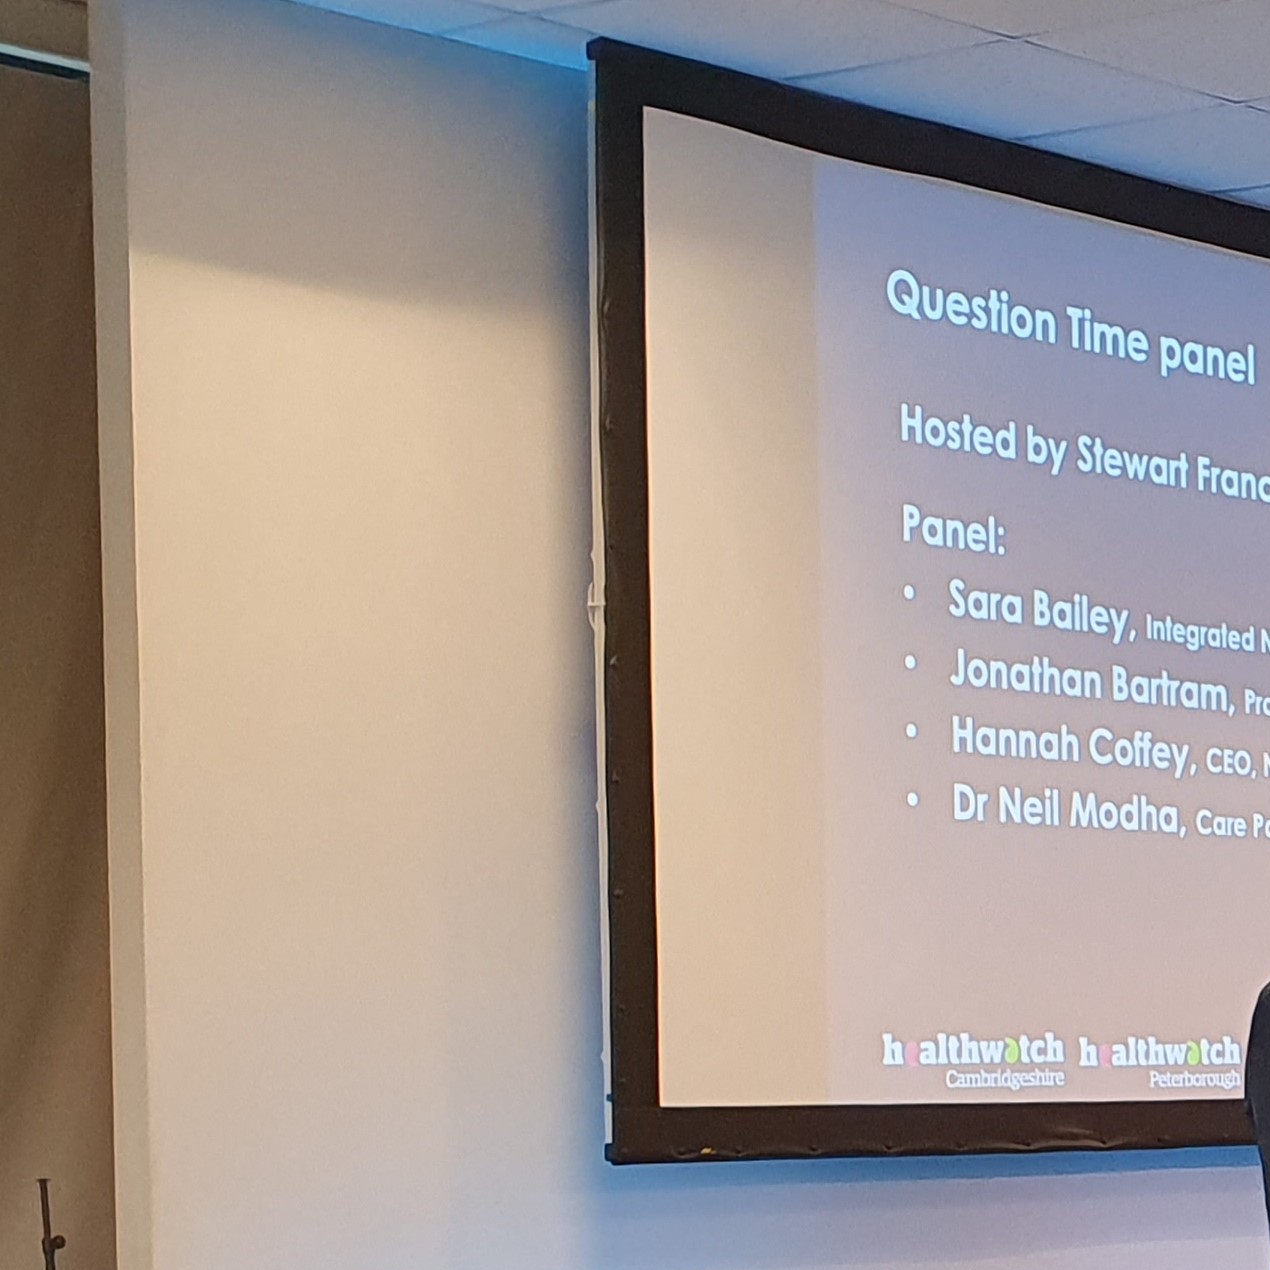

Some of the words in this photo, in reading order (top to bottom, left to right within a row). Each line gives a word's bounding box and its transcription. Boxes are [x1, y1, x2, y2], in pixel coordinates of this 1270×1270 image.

[886, 269, 1057, 344] Question
[1066, 305, 1149, 362] Time
[1159, 335, 1255, 386] panel
[901, 402, 1016, 459] Hosted
[1026, 424, 1068, 476] by
[1076, 434, 1188, 488] Stewart
[902, 503, 1006, 556] Panel:
[948, 578, 1023, 624] Sara
[1033, 588, 1137, 645] Bailey,
[1146, 613, 1256, 653] Integrated
[949, 647, 1102, 700] Jonathan
[1112, 664, 1236, 718] Bartram,
[952, 714, 1080, 763] Hannah
[1088, 727, 1198, 779] Coffey,
[1206, 748, 1258, 780] CEO,
[953, 783, 989, 821] Dr
[999, 785, 1060, 827] Neil
[1069, 791, 1188, 838] Modha,
[1195, 809, 1247, 838] Care
[882, 1032, 1065, 1068] healthwatch
[1078, 1036, 1241, 1069] healthwatch
[945, 1069, 1065, 1090] Cambridgeshire
[1149, 1069, 1241, 1089] Peterborough
